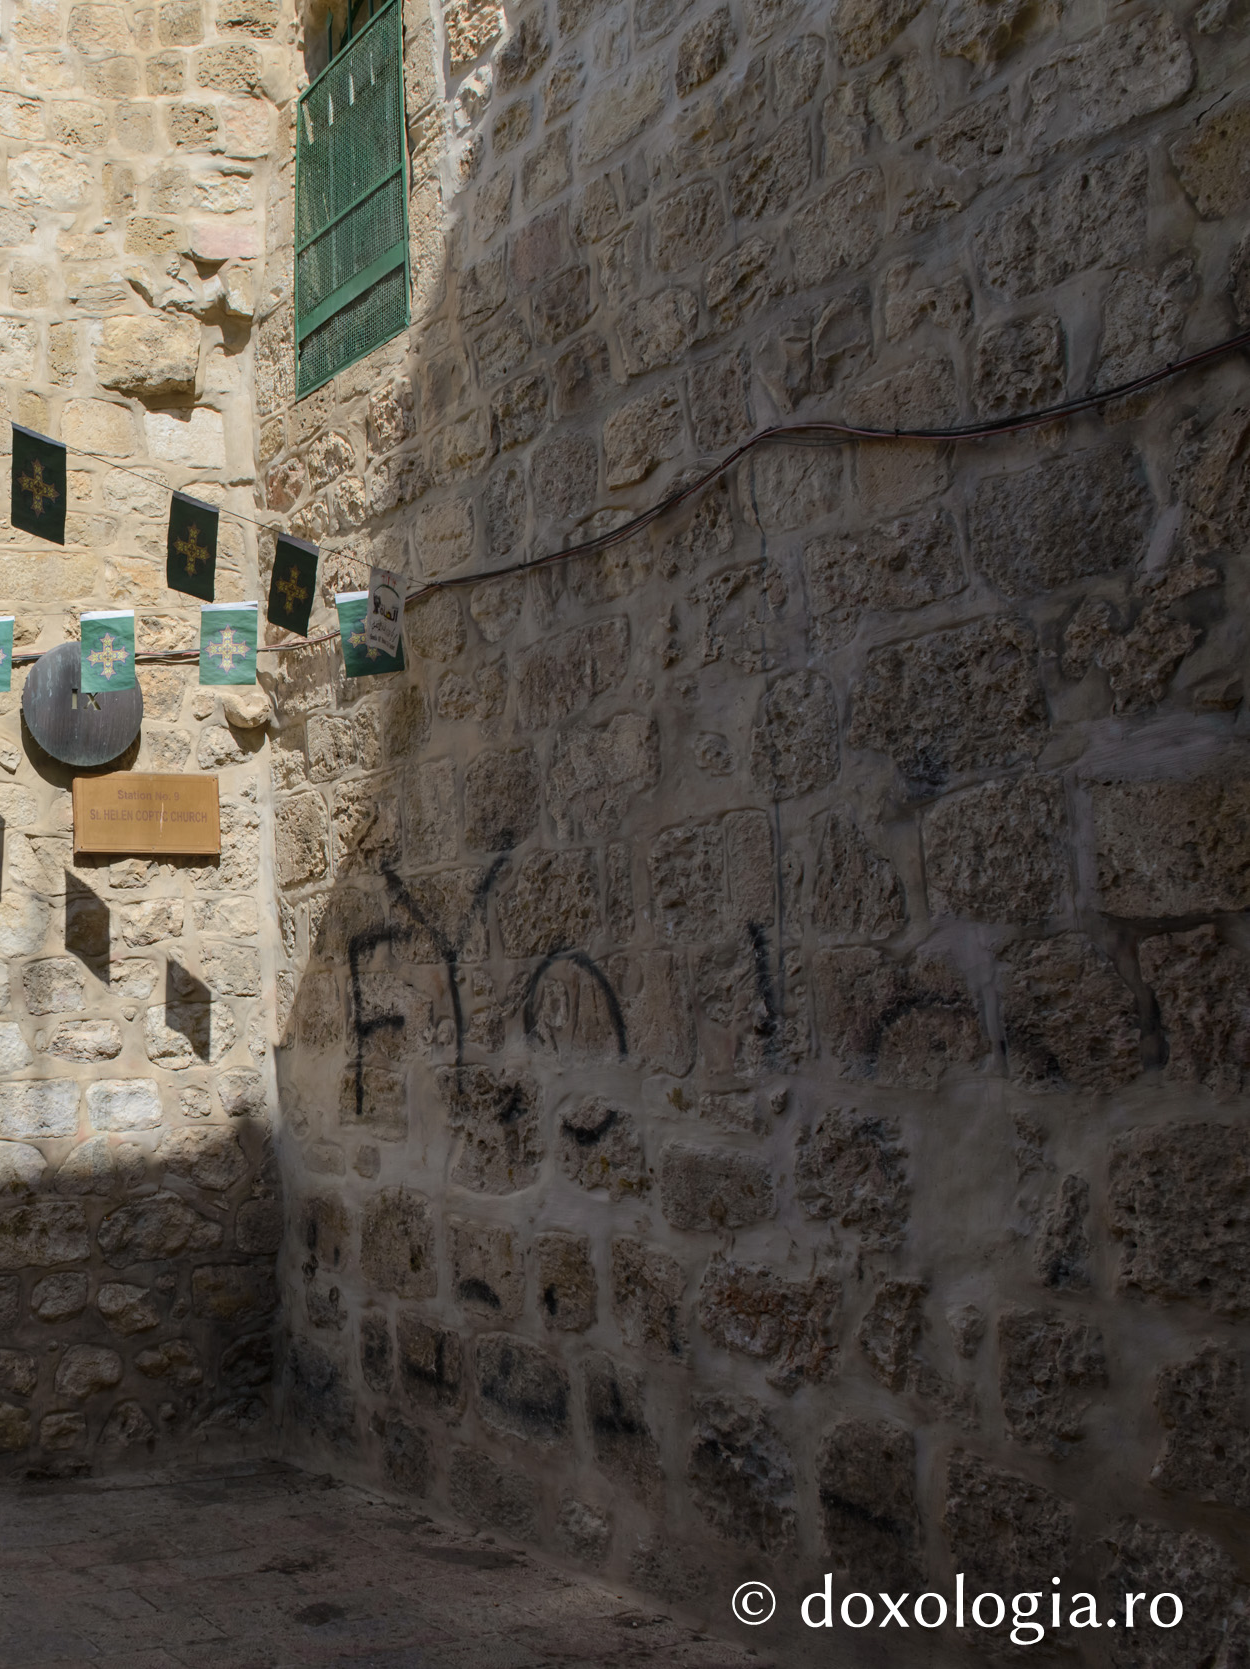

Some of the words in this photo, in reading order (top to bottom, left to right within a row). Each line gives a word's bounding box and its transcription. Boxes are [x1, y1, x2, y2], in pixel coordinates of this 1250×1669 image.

[71, 688, 102, 711] IX
[117, 789, 152, 801] Station
[154, 791, 171, 802] No.
[173, 792, 180, 802] 9
[103, 809, 134, 822] HELEN
[135, 809, 168, 823] COPTIC
[170, 810, 208, 824] CHURCH
